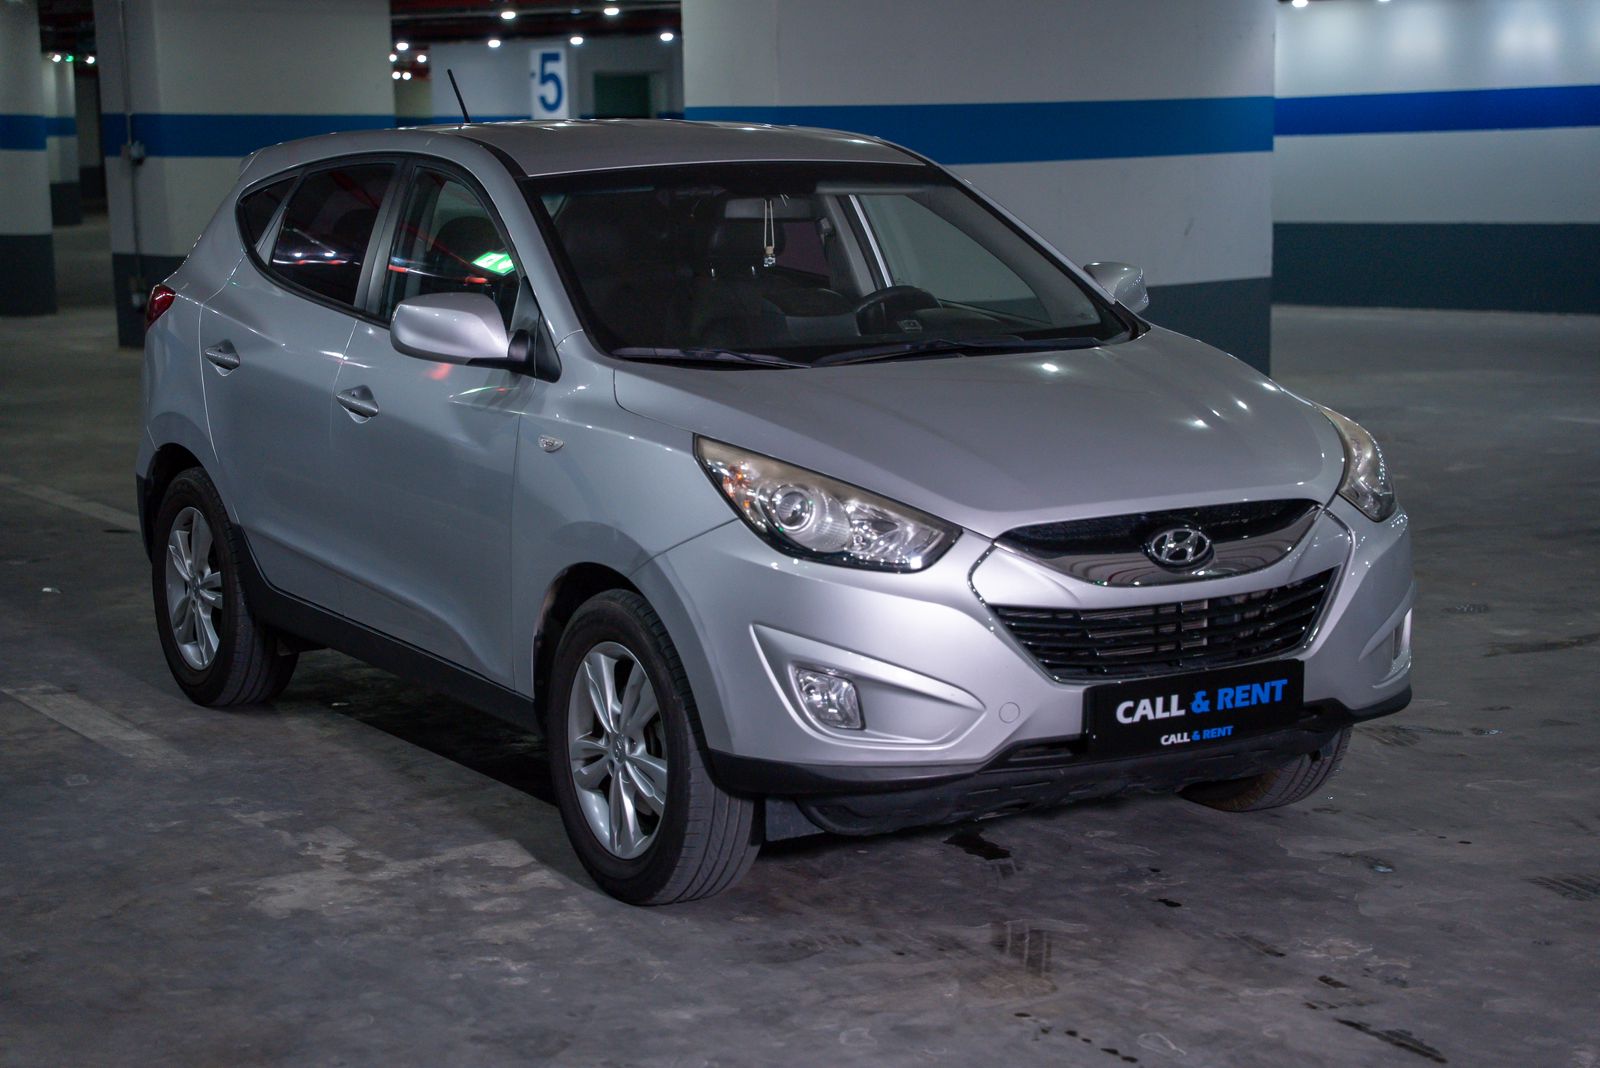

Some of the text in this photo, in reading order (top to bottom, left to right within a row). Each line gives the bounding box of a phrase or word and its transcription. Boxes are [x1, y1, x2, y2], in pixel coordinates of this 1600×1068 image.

[1115, 679, 1288, 724] CALL & RENT
[1160, 725, 1234, 746] CALL & RENT
